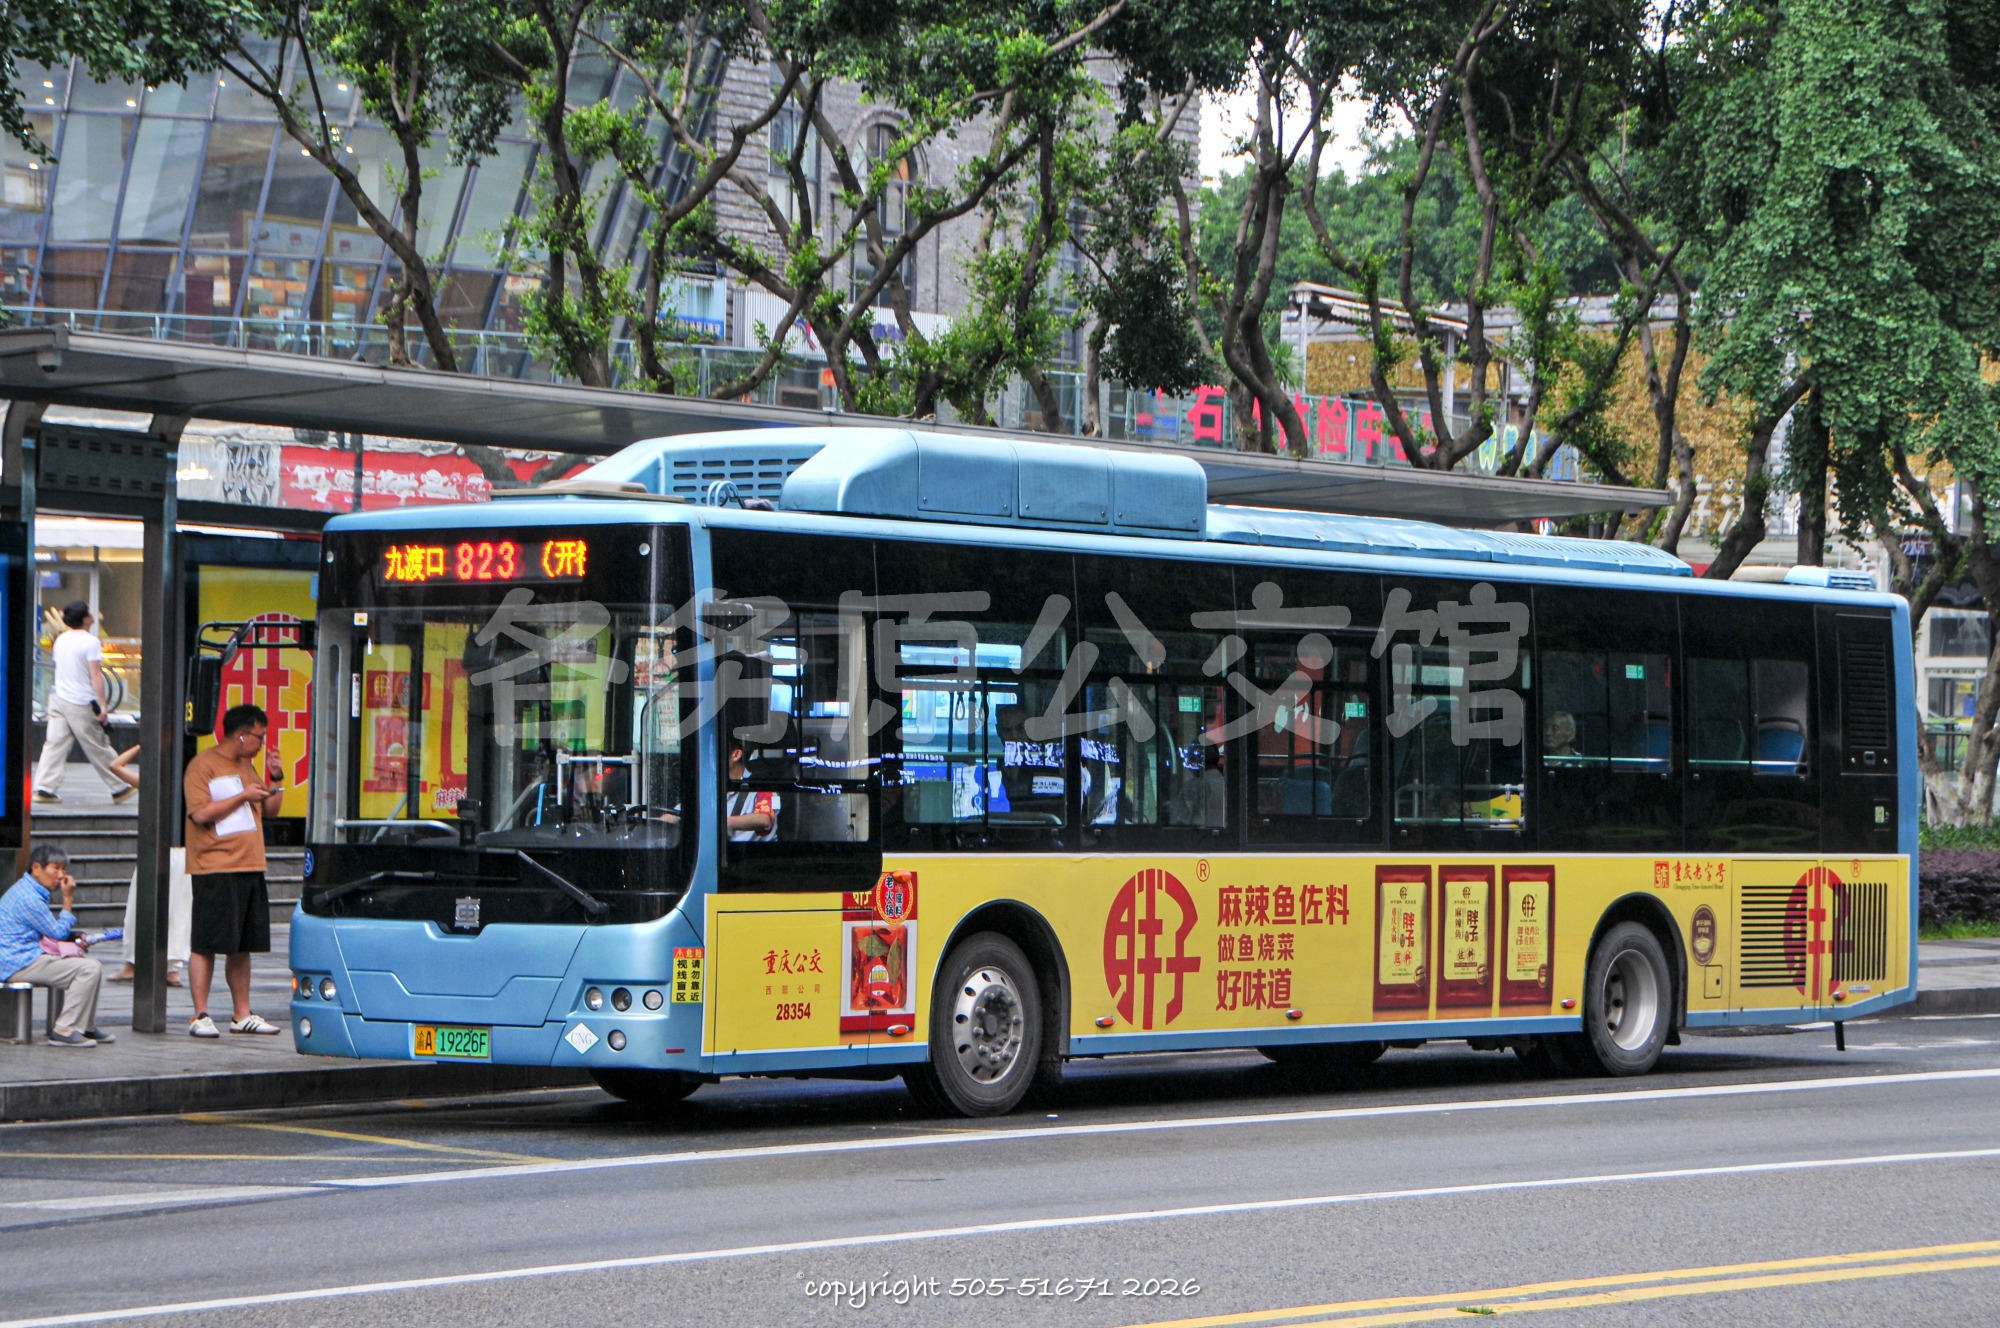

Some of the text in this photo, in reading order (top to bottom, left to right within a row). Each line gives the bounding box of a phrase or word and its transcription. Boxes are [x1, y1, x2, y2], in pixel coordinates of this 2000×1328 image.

[385, 545, 444, 581] 九渡口
[456, 541, 515, 580] 823
[1672, 860, 1726, 883] 重庆老字号
[885, 875, 894, 917] 老火锅
[1217, 884, 1350, 927] 麻辣鱼佐料
[1466, 909, 1479, 943] 胖子
[686, 948, 702, 958] 危险
[763, 948, 823, 975] 重庆公交
[1217, 933, 1295, 962] 做鱼烧菜
[676, 959, 688, 1002] 视线盲区
[690, 959, 701, 1002] 请勿靠近
[765, 984, 820, 995] 西部公司
[1216, 968, 1292, 1011] 好味道
[776, 1002, 811, 1021] 28354
[440, 1031, 488, 1053] 19226F
[571, 1032, 592, 1045] CNG
